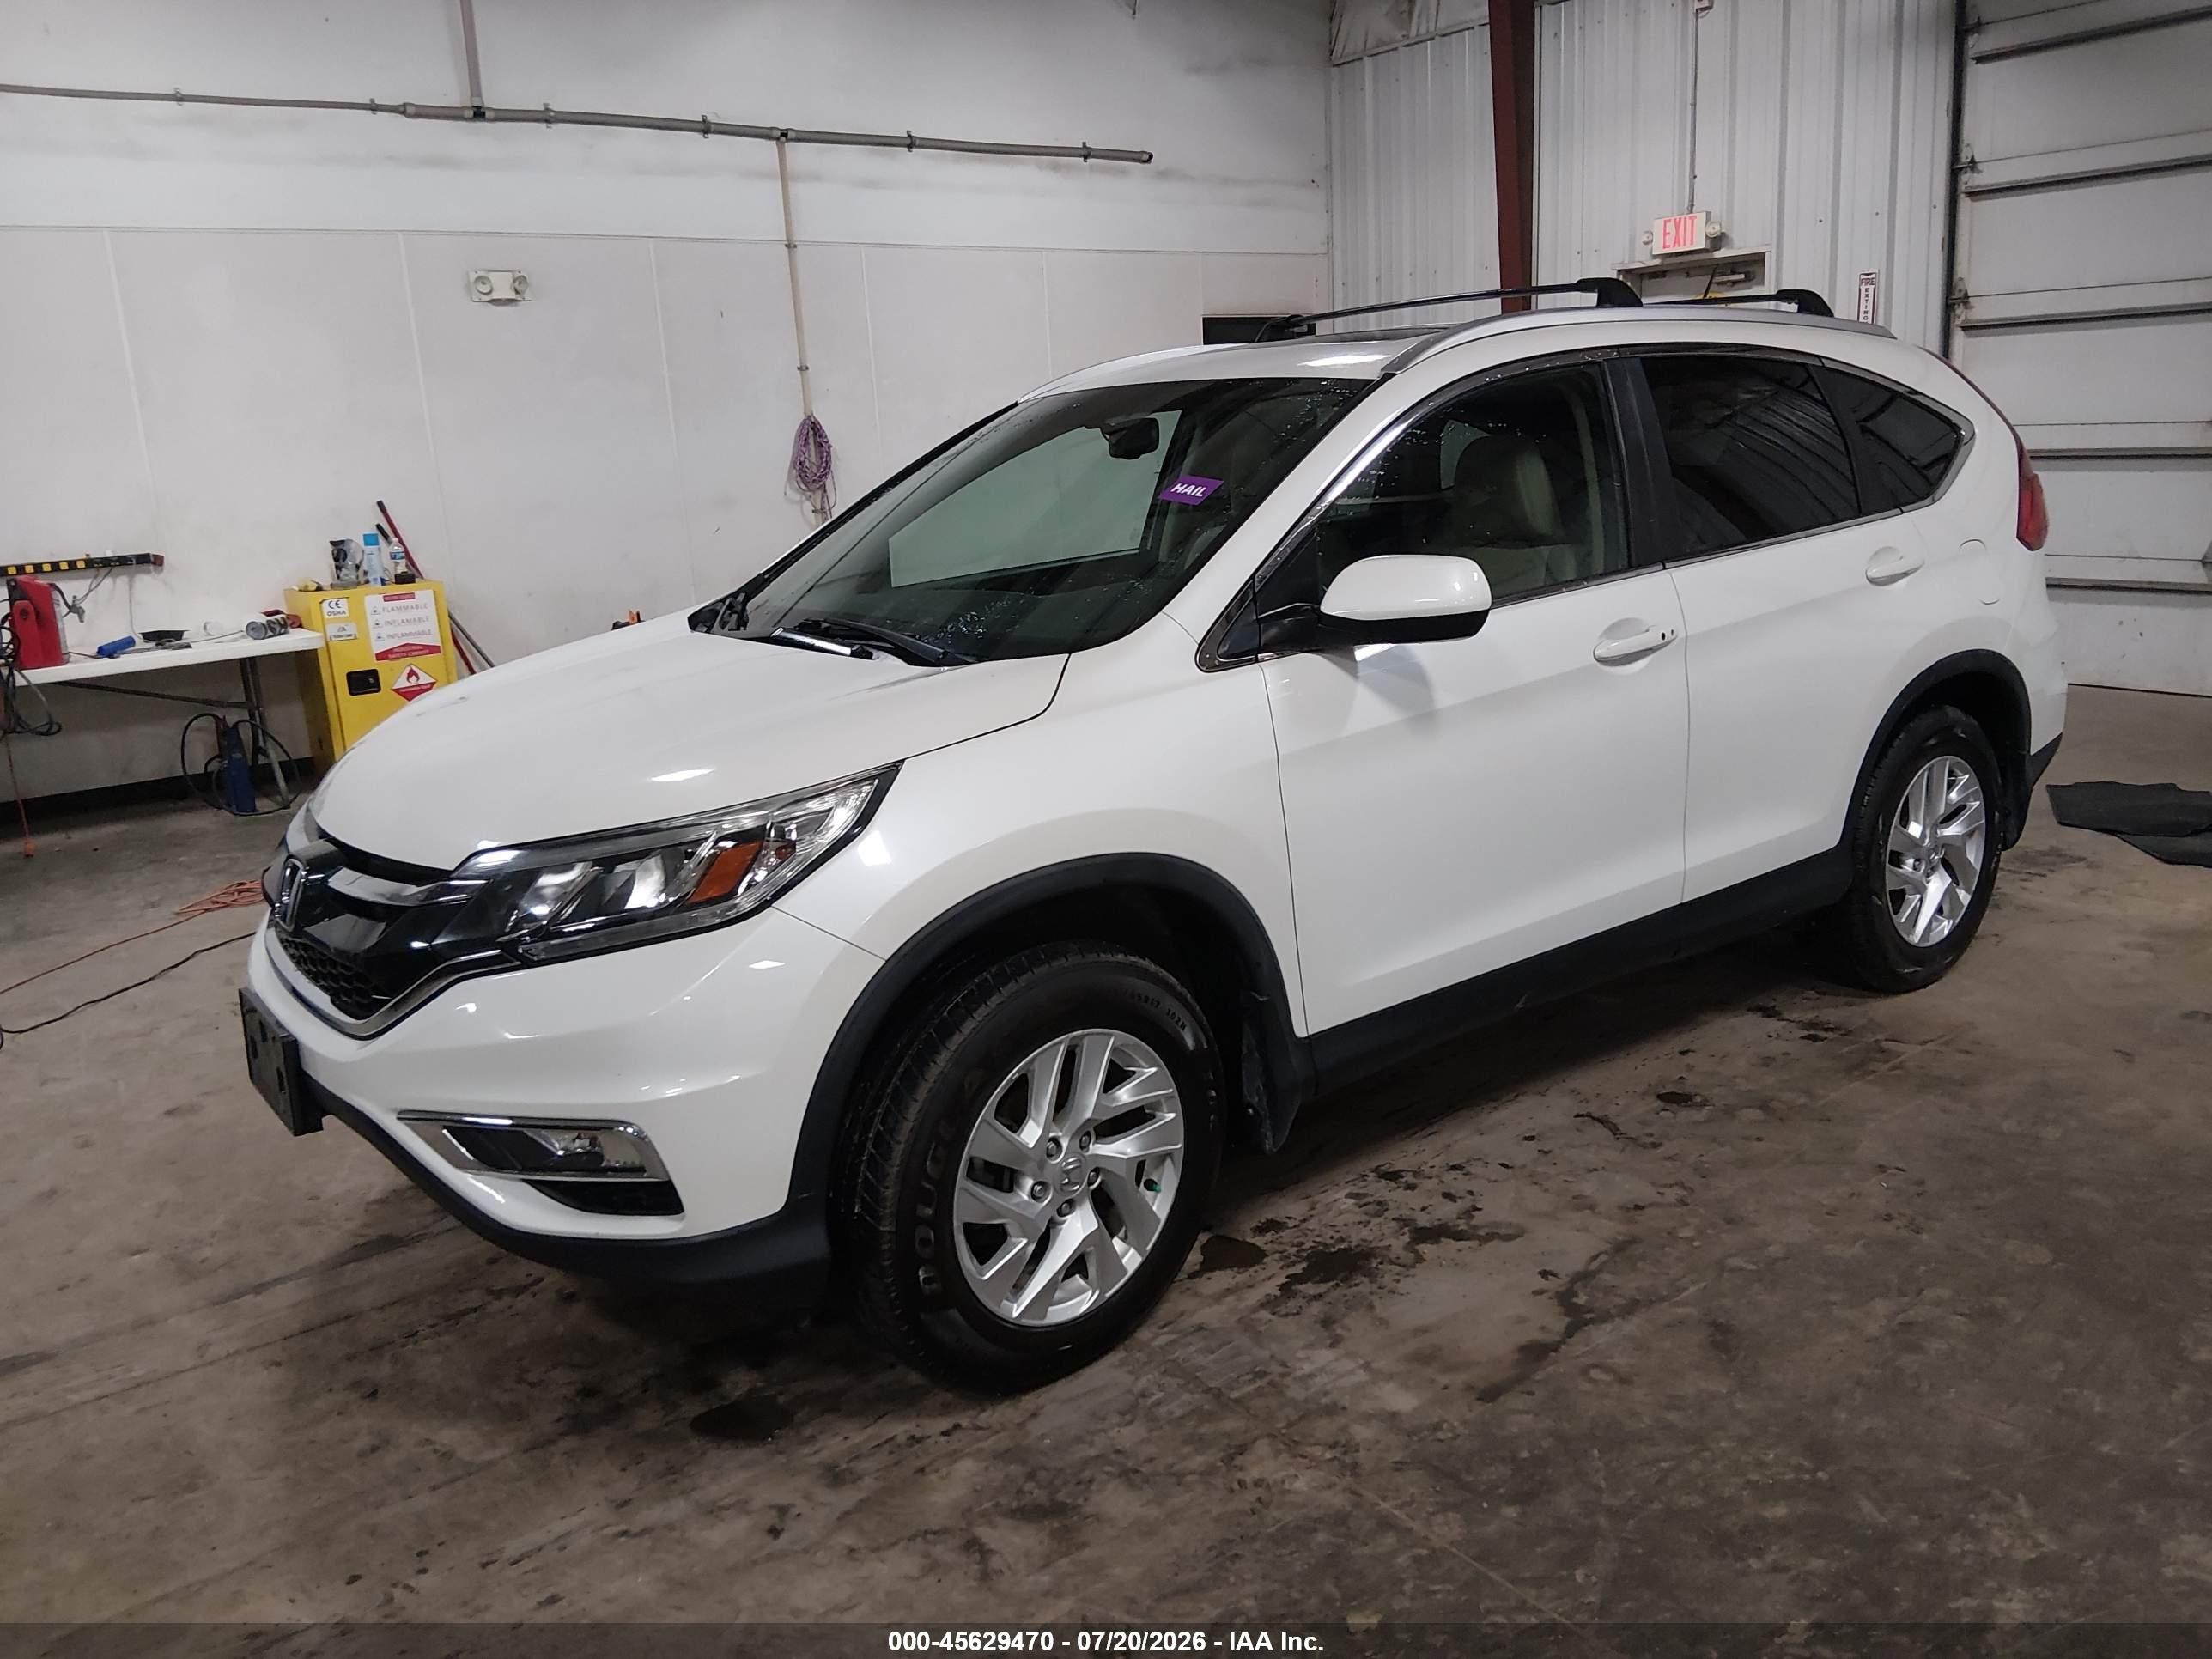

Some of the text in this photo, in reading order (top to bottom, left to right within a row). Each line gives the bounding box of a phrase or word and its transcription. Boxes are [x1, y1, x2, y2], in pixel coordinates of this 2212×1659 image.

[1662, 215, 1697, 249] EXIT
[1860, 277, 1876, 286] FIRE
[1862, 287, 1870, 323] EXTING
[1170, 483, 1206, 496] HAIL
